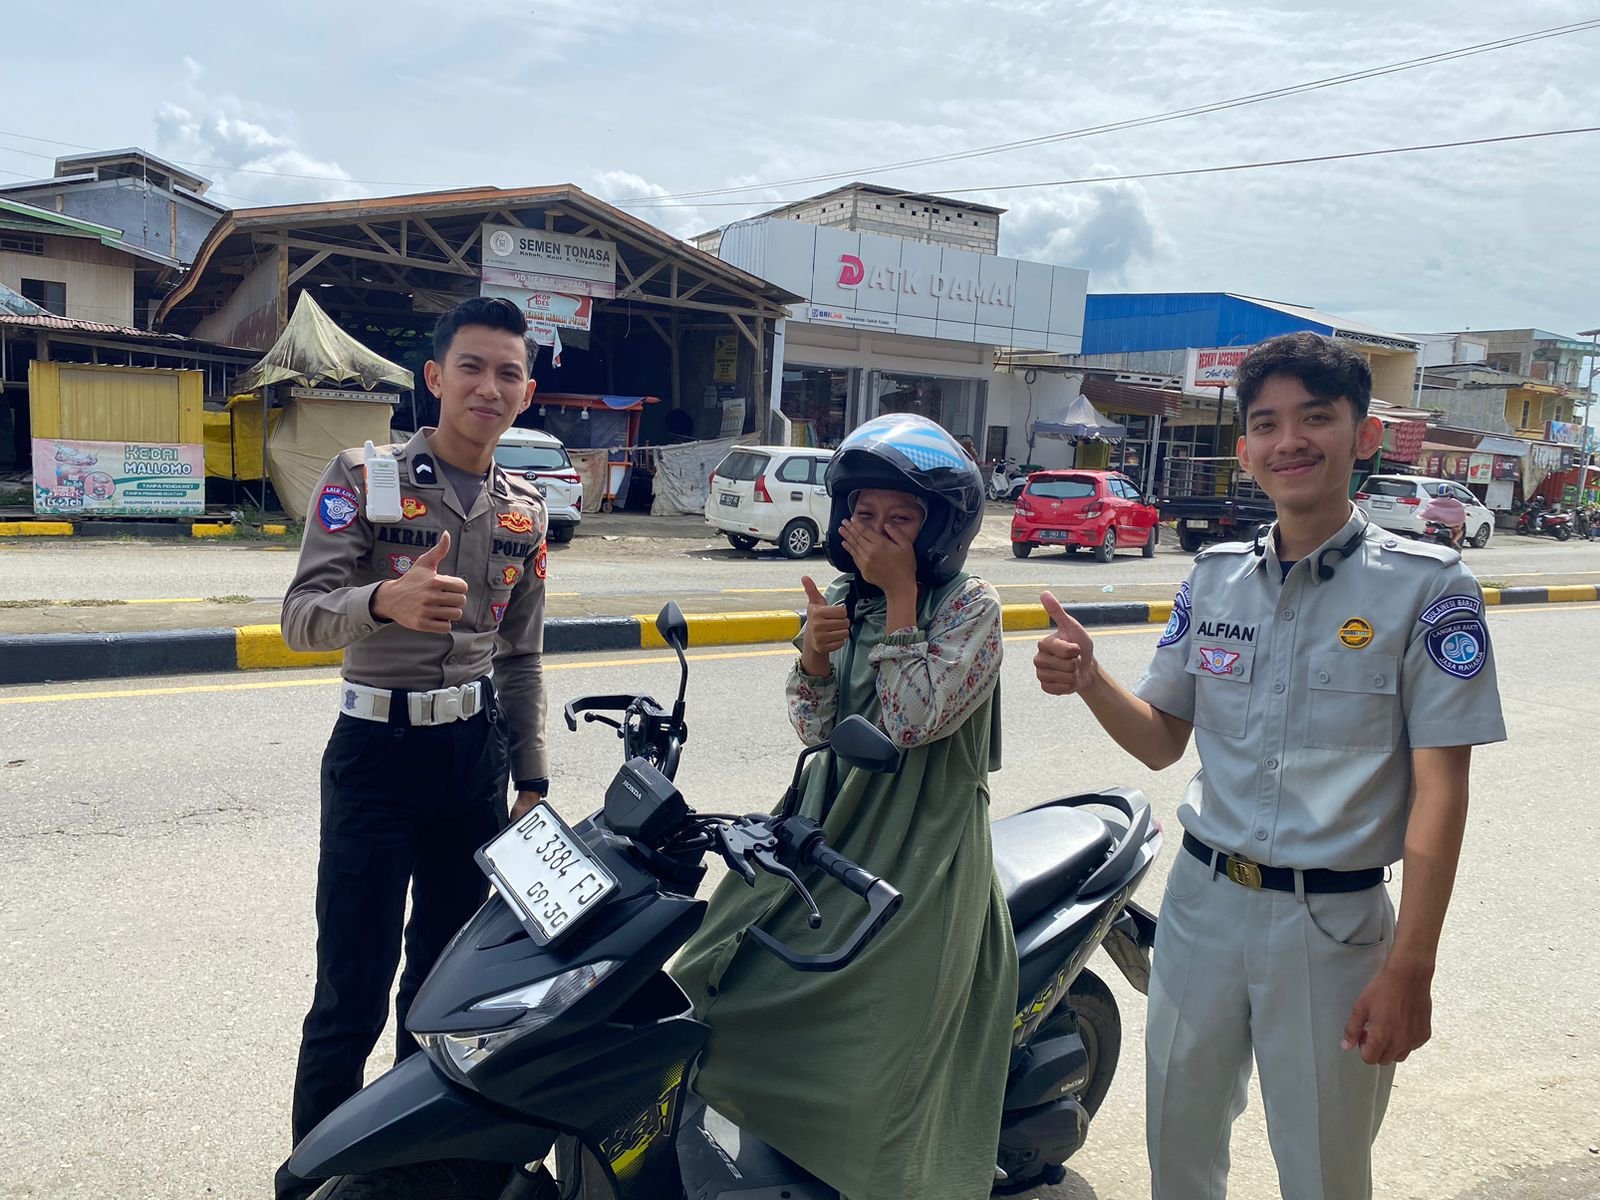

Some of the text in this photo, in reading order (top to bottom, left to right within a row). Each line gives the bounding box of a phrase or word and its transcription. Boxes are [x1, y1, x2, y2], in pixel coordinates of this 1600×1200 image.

[519, 238, 611, 263] SEMEN TONASA
[929, 271, 1016, 308] DAMAI
[124, 445, 179, 461] KEDAI
[124, 461, 193, 475] MALLOMO
[377, 526, 439, 547] AKRAM
[1426, 599, 1478, 621] SULAWESI BARAT
[1196, 620, 1255, 642] ALFIAN
[1439, 651, 1484, 671] JASA RAHARJA
[622, 780, 642, 800] HONDA
[517, 812, 604, 906] DC 3384 FJ
